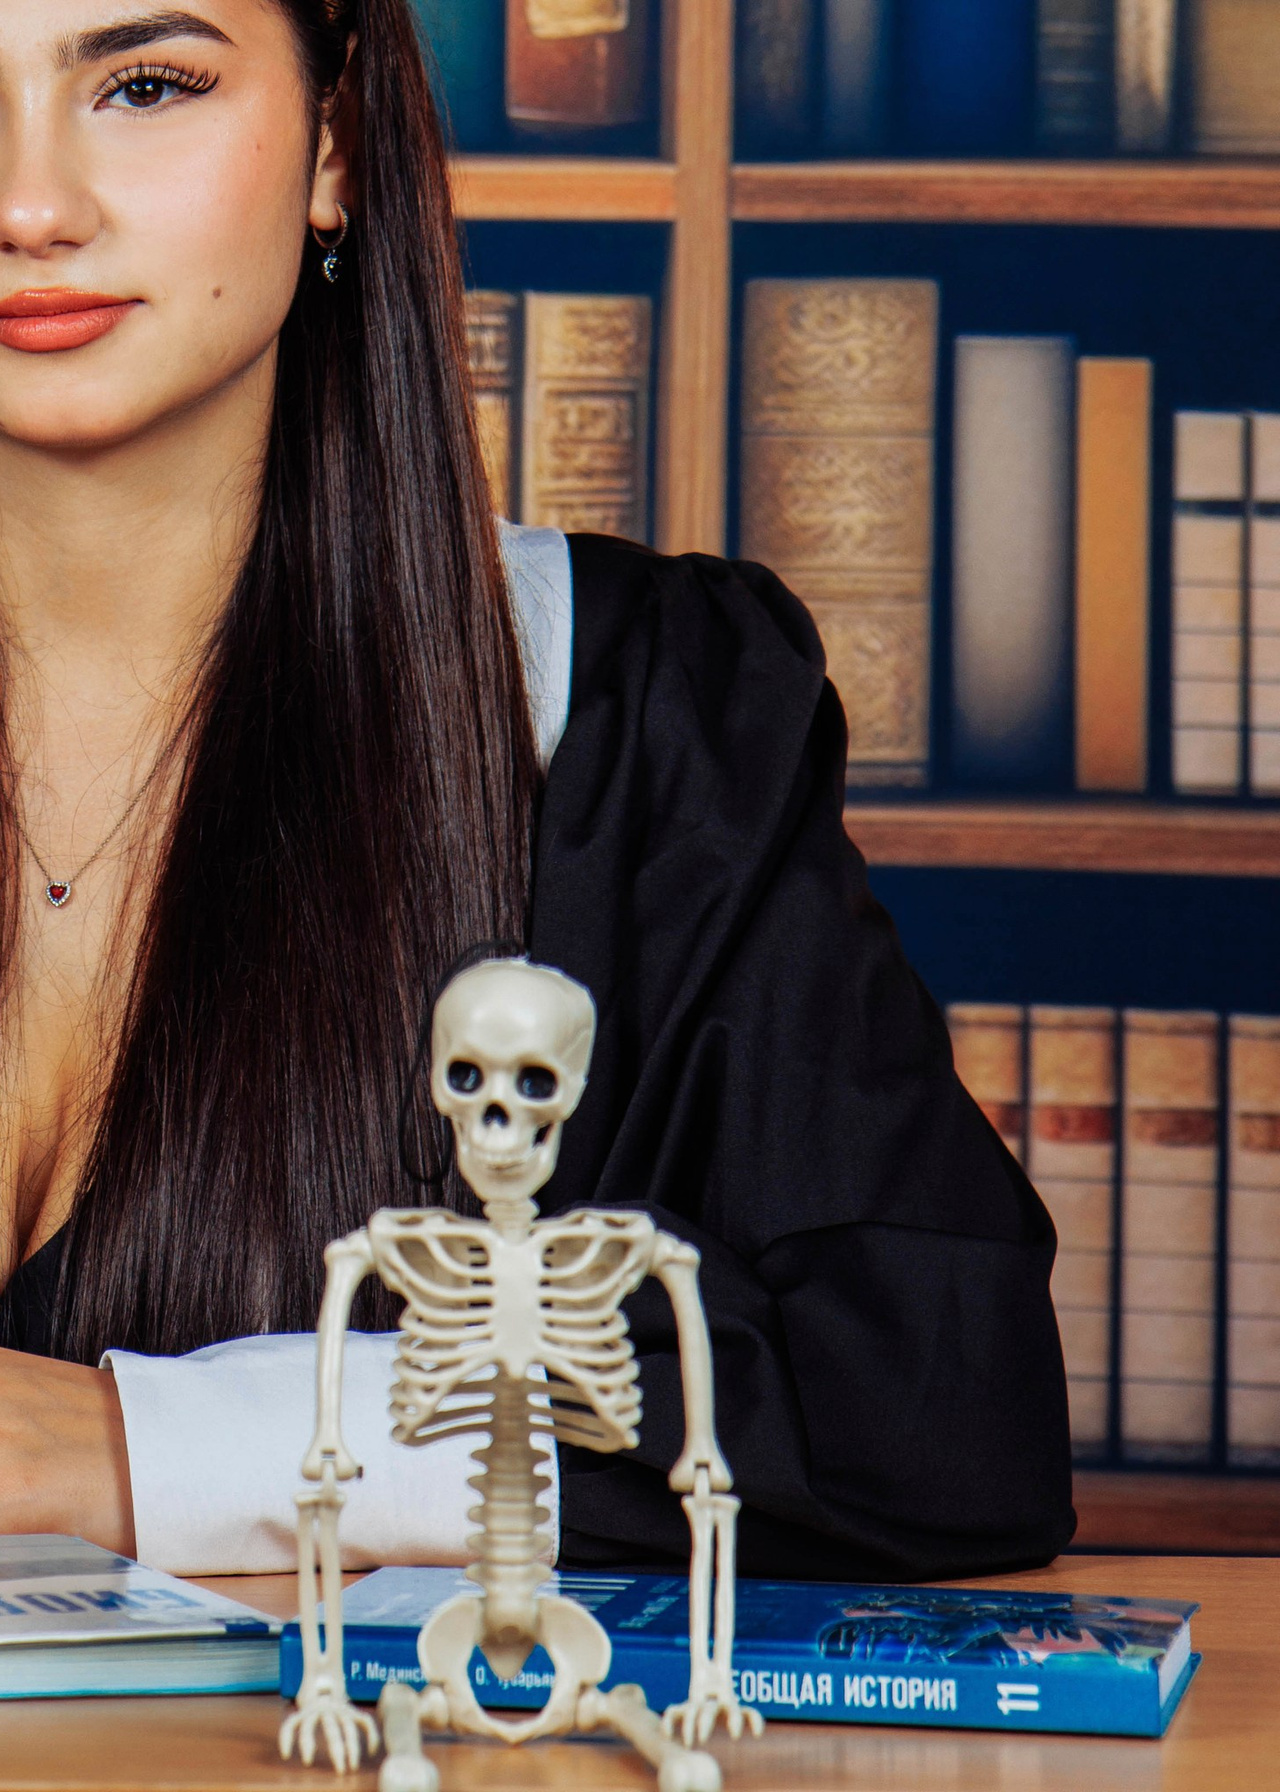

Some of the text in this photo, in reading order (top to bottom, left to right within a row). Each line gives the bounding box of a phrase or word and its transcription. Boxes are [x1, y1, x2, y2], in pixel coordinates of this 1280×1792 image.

[731, 1669, 956, 1711] ЕОБЩАЯ ИСТОРИЯ
[997, 1682, 1039, 1715] 11
